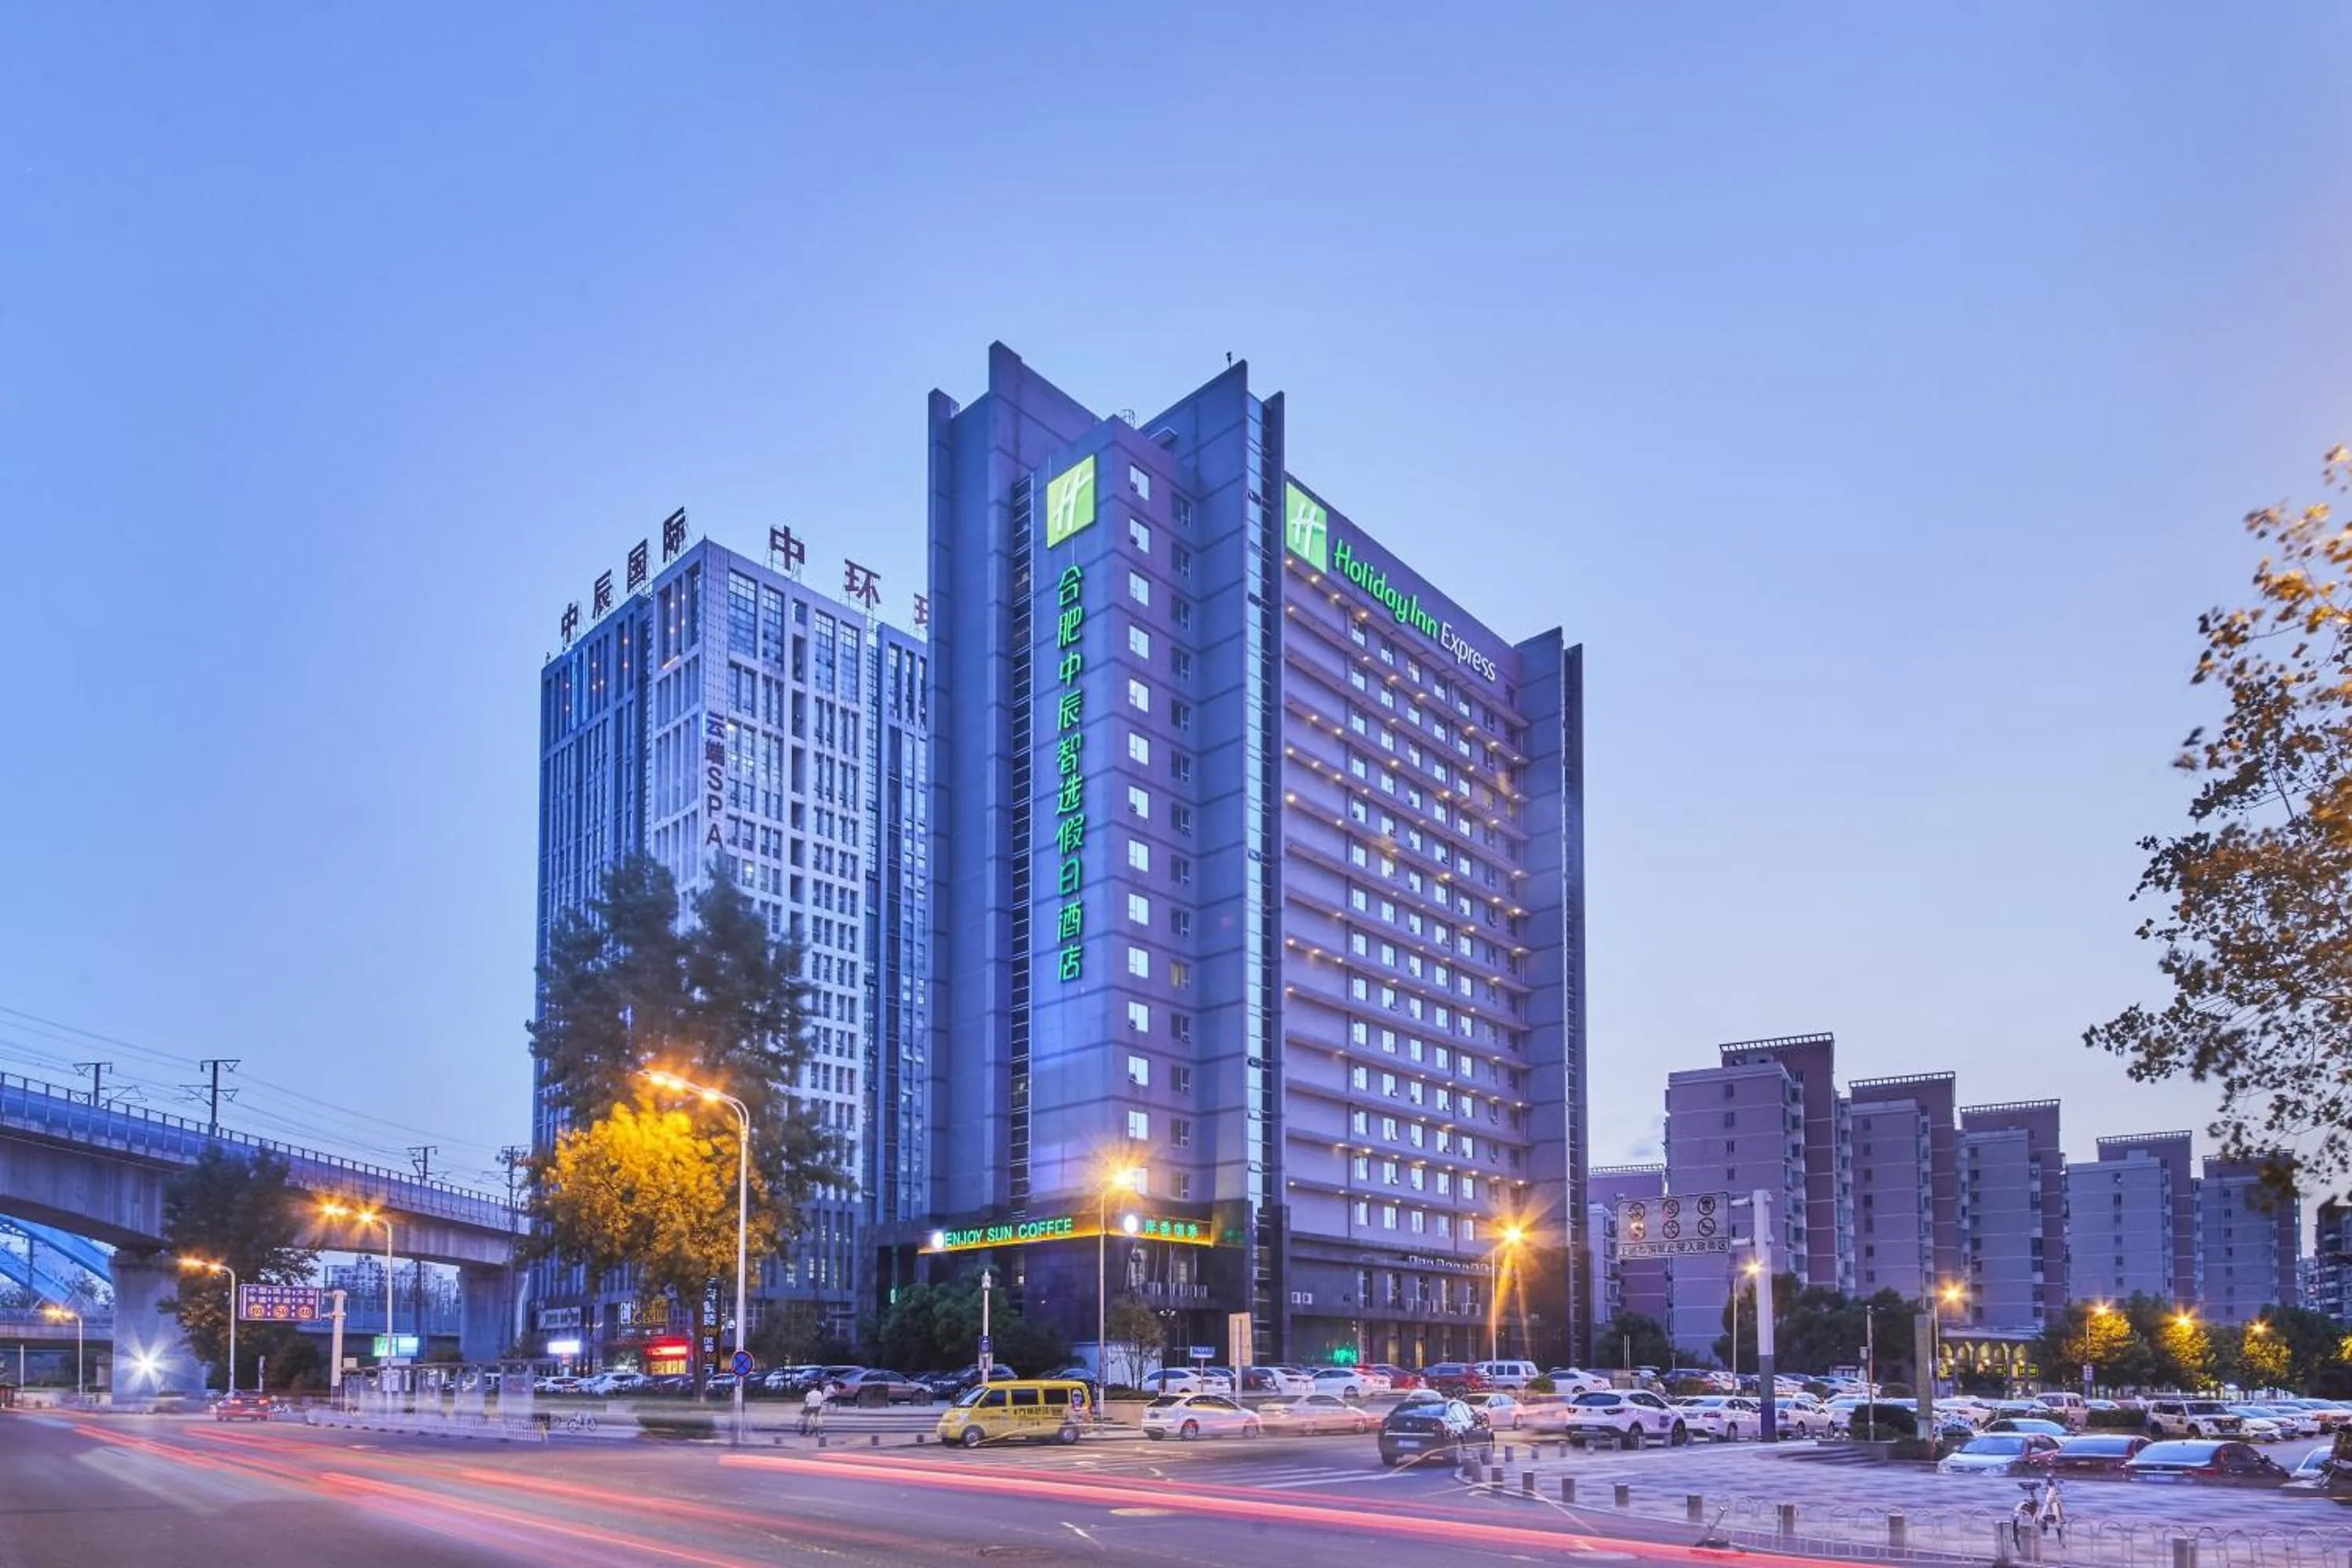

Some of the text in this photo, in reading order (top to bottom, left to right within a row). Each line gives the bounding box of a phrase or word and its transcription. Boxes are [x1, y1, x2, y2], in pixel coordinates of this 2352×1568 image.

[561, 506, 687, 641] 中辰国际
[1334, 539, 1496, 681] Holiday Inn Express
[1055, 564, 1084, 982] 合肥中辰智选假日酒店
[944, 1218, 1073, 1247] ENJOY SUN COFFEE
